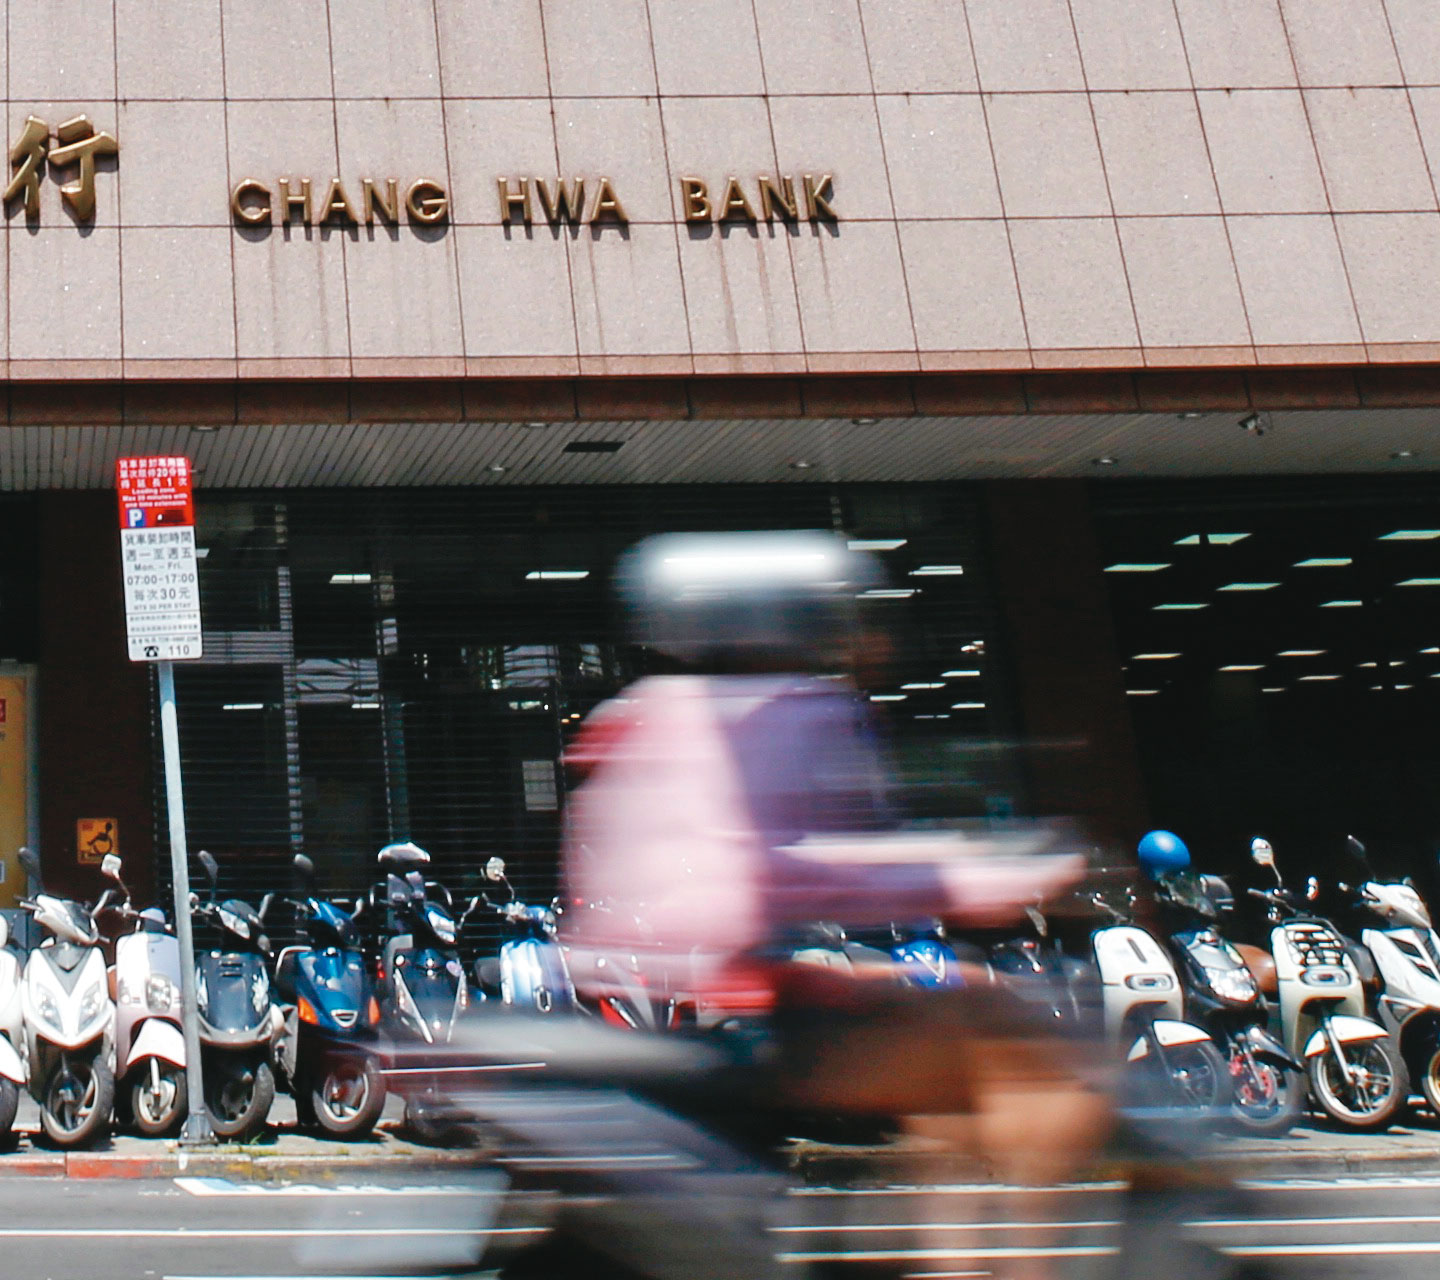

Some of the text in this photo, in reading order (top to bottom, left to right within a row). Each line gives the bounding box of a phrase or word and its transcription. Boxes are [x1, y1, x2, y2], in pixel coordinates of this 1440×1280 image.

[231, 173, 838, 224] CHANG HWA BANK
[129, 508, 142, 527] P
[126, 547, 192, 561] 週一至週五
[127, 573, 195, 586] 07:00-17:00
[134, 586, 191, 601] 每次30元
[169, 645, 190, 656] 110
